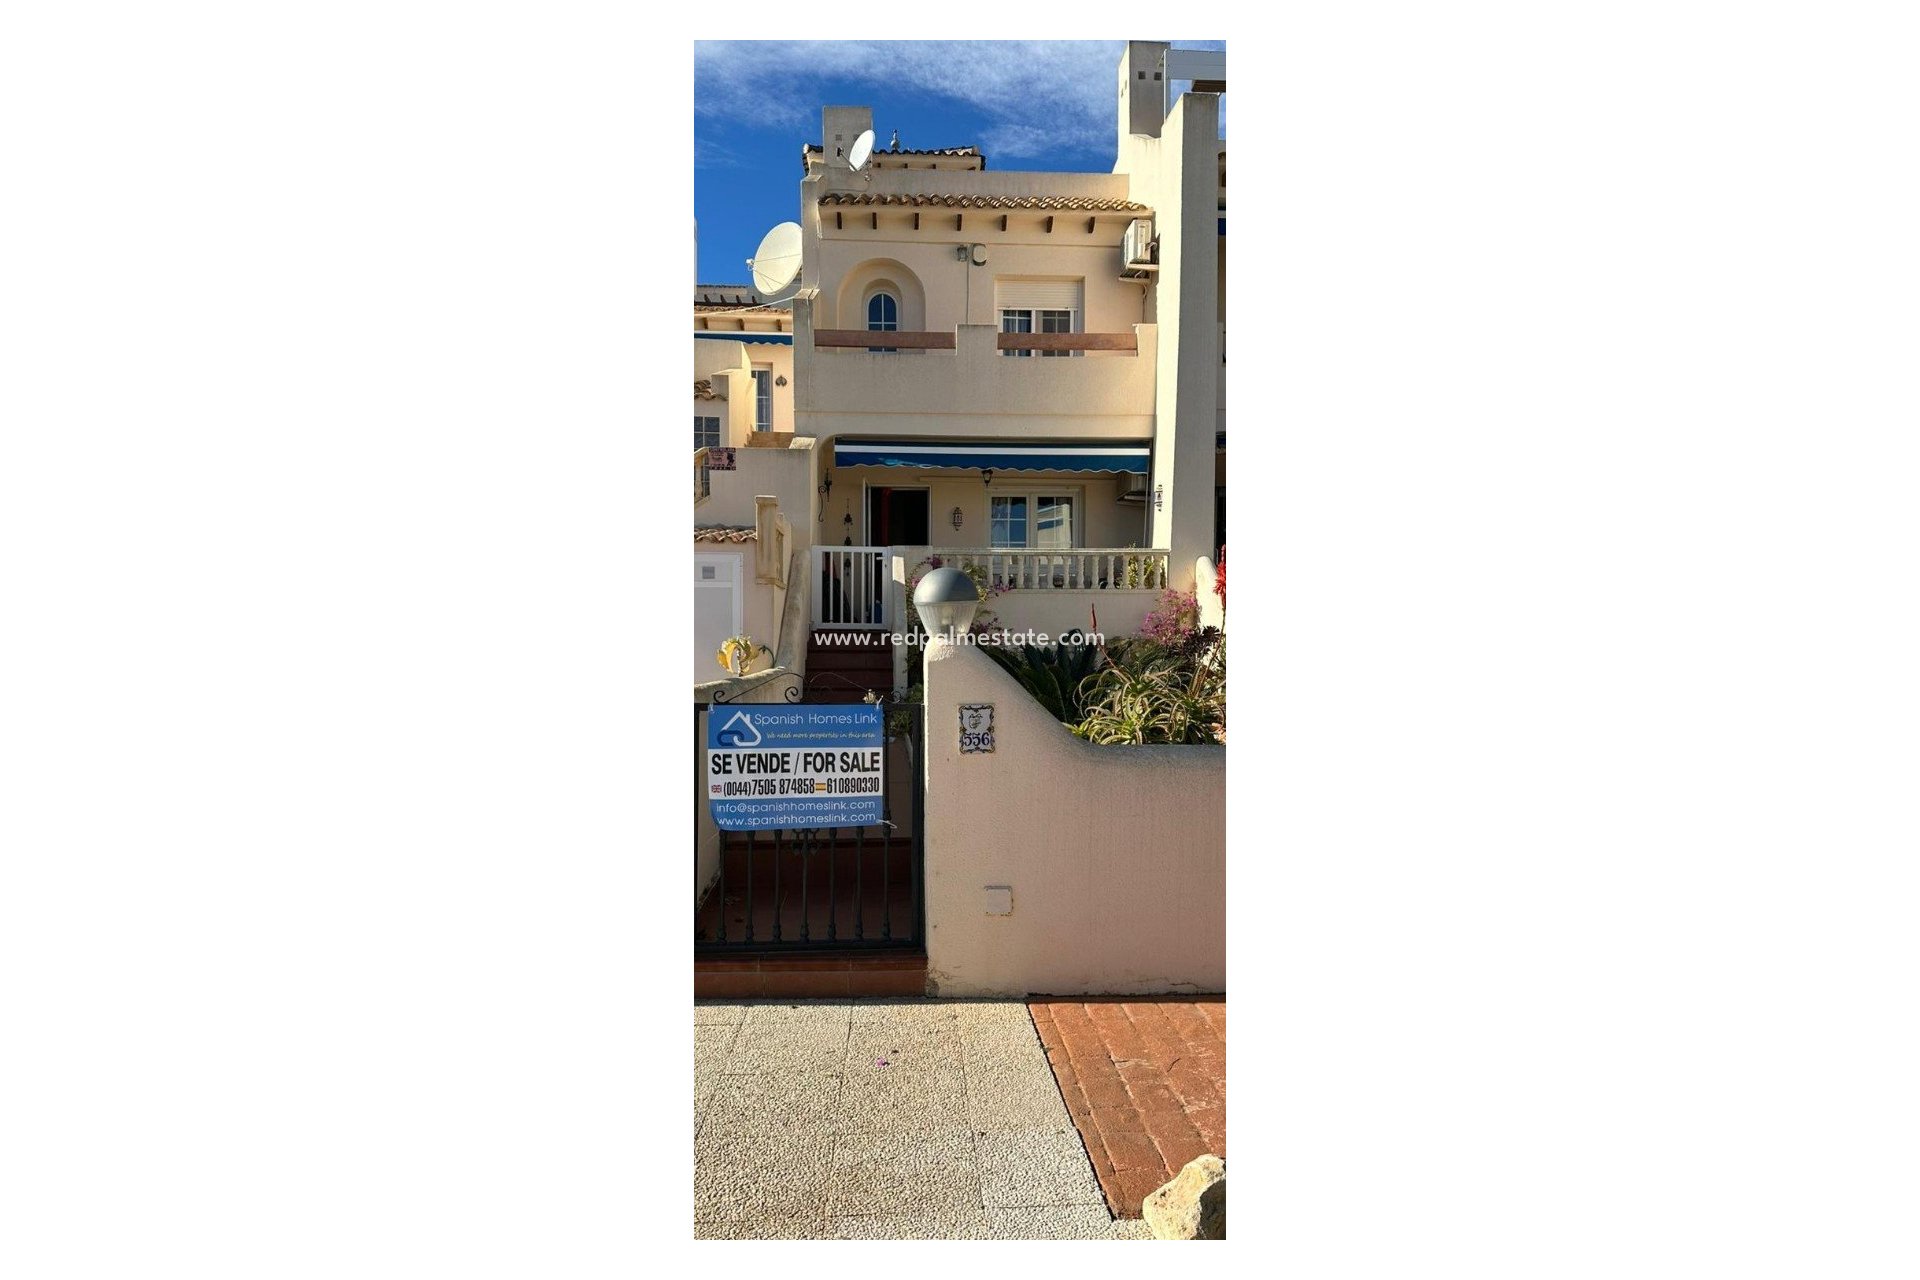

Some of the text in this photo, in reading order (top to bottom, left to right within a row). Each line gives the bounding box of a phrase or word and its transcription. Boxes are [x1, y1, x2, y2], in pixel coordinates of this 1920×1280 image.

[754, 713, 878, 726] Spanish Homes Link
[963, 732, 990, 747] 556
[711, 751, 880, 776] SE VENDE / FOR SALE
[779, 778, 815, 795] 874858
[826, 777, 880, 794] 610890330
[716, 801, 876, 814] info@spanishhomeslink.com
[716, 813, 876, 826] www.spanishhomeslink.com
